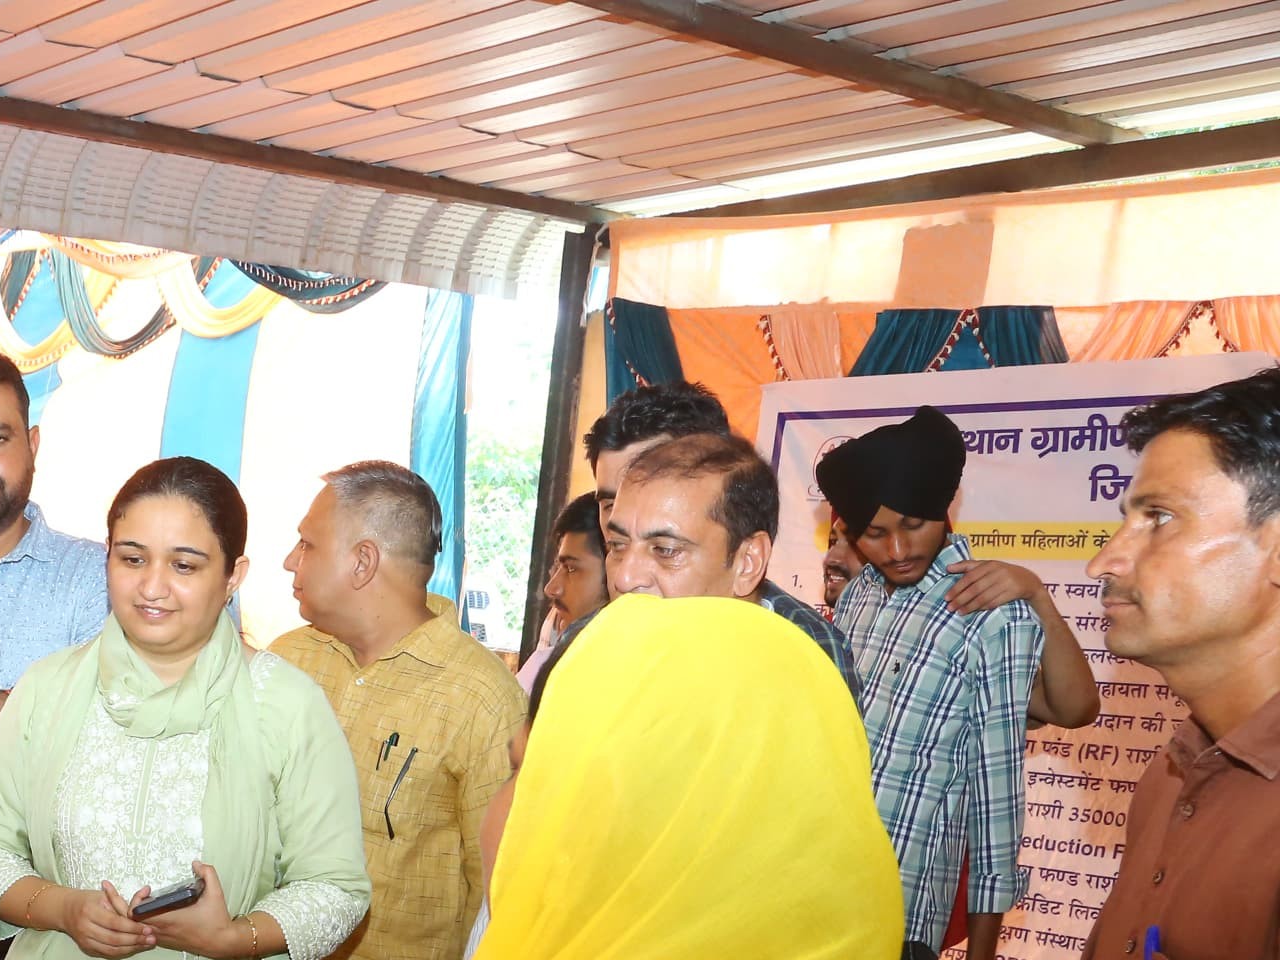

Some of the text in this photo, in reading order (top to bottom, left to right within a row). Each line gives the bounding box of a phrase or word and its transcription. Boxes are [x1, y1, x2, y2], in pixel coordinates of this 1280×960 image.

[962, 429, 1022, 454] थान
[970, 529, 1016, 548] ग्रामीण
[1021, 529, 1088, 549] महिलाओं
[792, 574, 803, 589] 1.
[1096, 681, 1149, 699] हायता
[1140, 712, 1167, 732] की
[1041, 737, 1074, 758] फंड
[1078, 743, 1119, 766] (RF)
[1068, 806, 1126, 828] 35000
[1021, 834, 1106, 859] eduction
[1038, 867, 1081, 887] फण्ड
